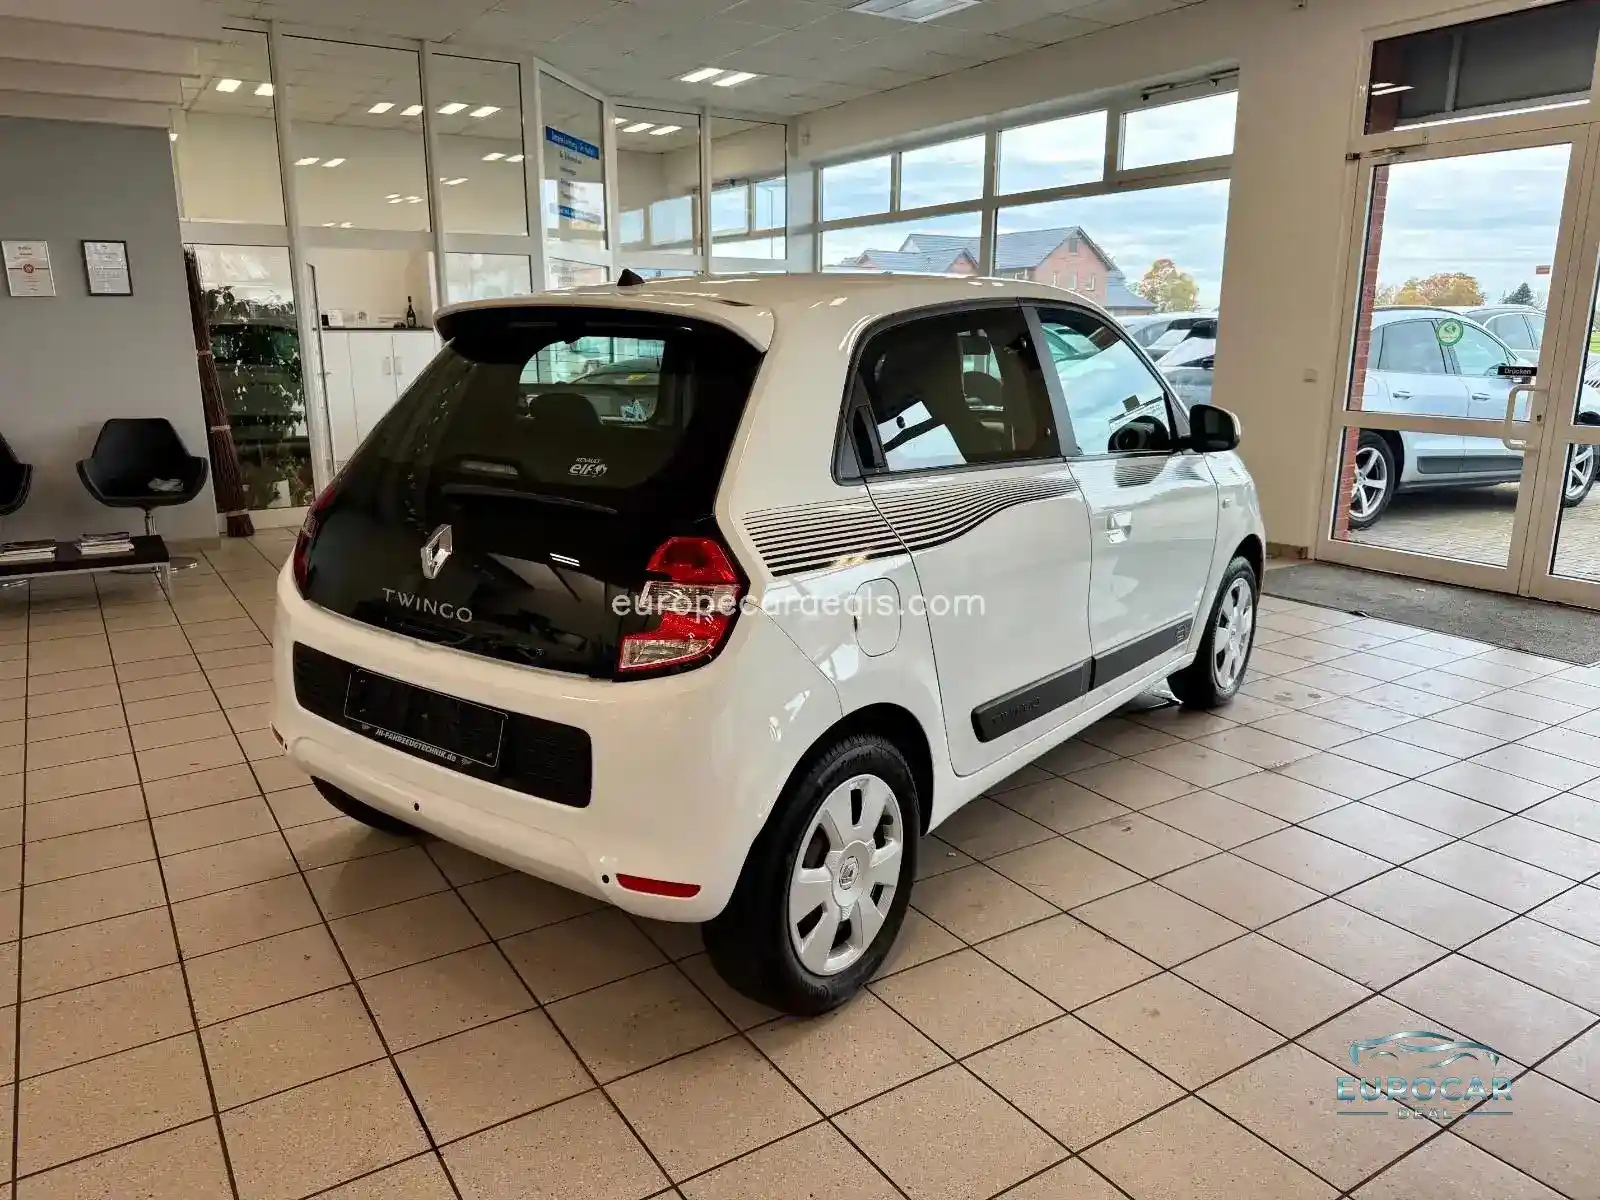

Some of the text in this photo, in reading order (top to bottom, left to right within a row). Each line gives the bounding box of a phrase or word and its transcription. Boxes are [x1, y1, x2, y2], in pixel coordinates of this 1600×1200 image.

[1504, 366, 1532, 375] Drücken
[570, 463, 596, 475] elf
[382, 588, 472, 622] TWINGO
